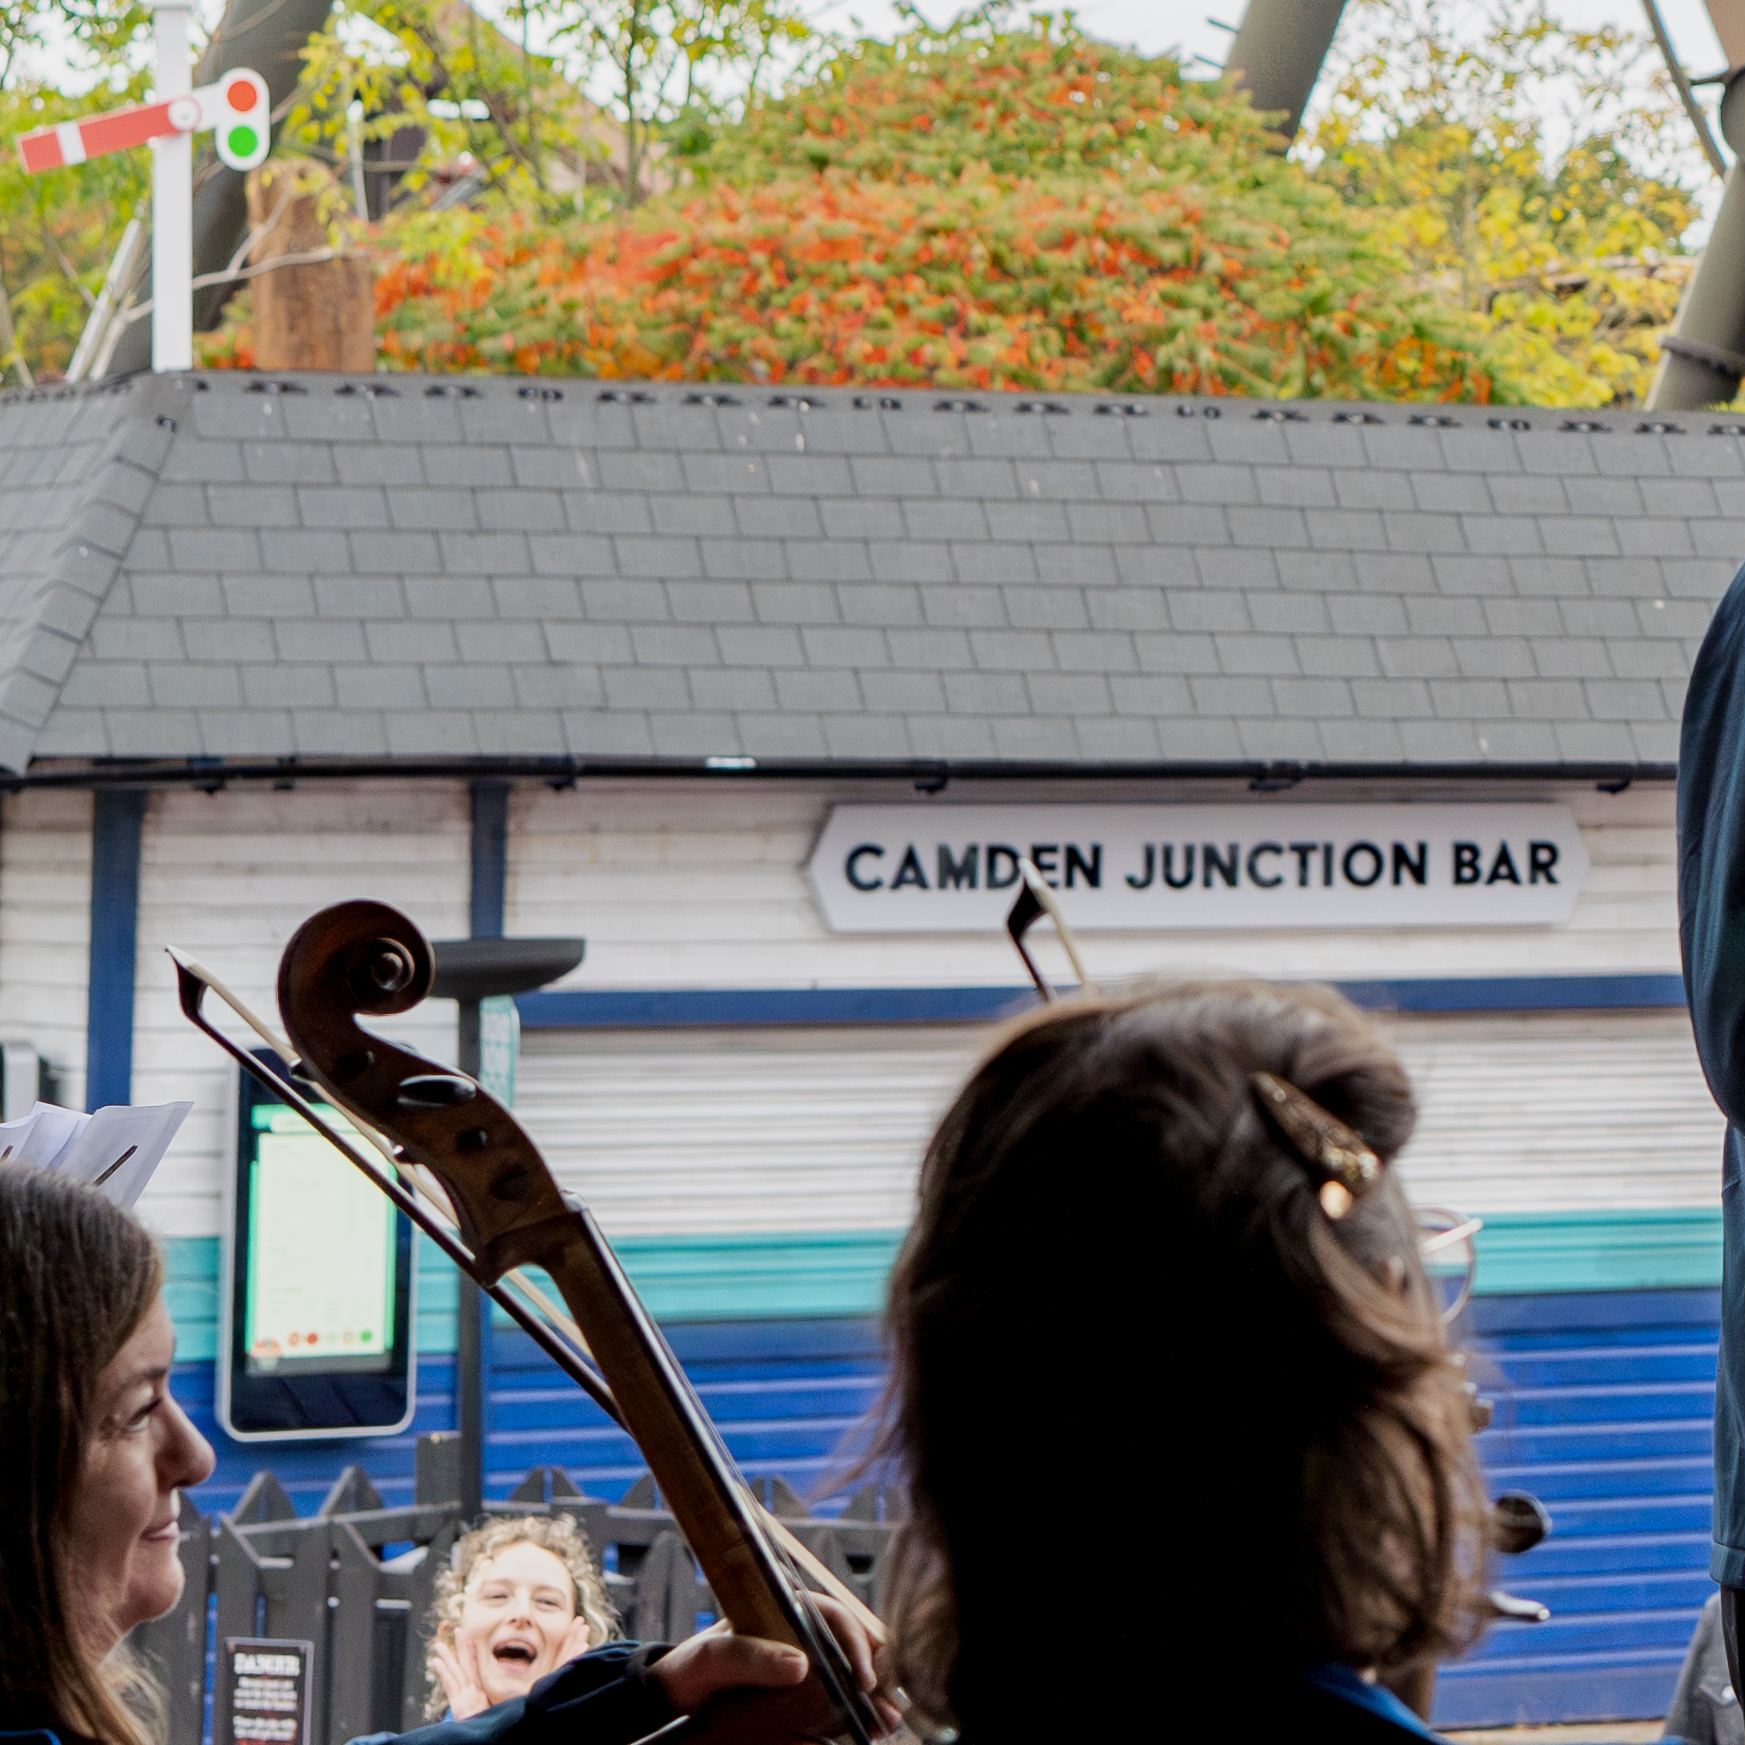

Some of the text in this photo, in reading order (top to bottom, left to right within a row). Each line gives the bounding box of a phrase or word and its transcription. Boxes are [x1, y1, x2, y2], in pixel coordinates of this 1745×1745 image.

[845, 840, 1560, 891] CAMDEN JUNCTION BAR
